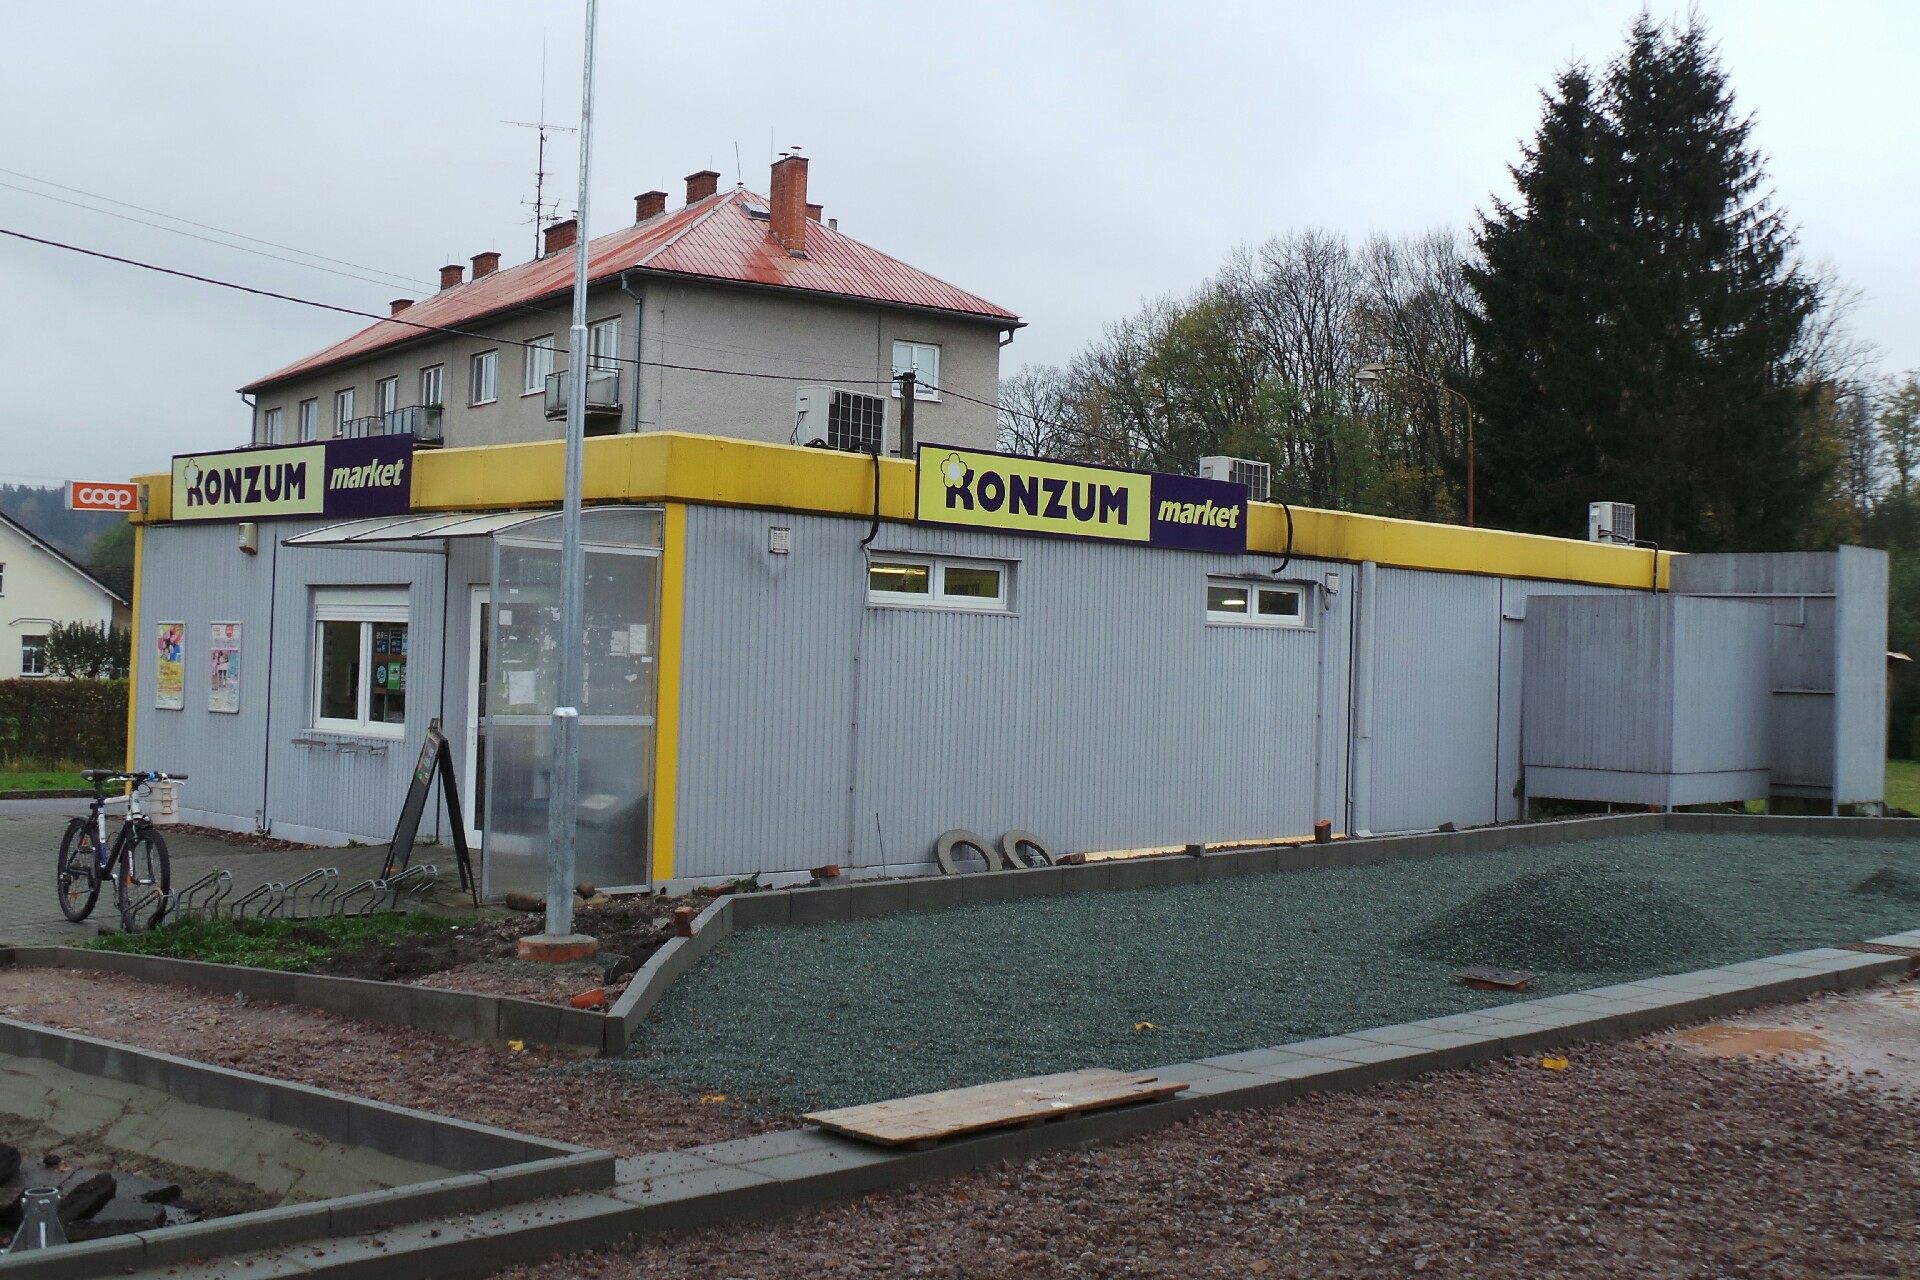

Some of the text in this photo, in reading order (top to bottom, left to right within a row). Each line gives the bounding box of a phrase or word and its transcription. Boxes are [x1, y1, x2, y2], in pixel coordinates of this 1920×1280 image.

[78, 487, 132, 509] coop
[187, 458, 405, 507] KONZUM market
[945, 468, 1240, 529] KONZUM market
